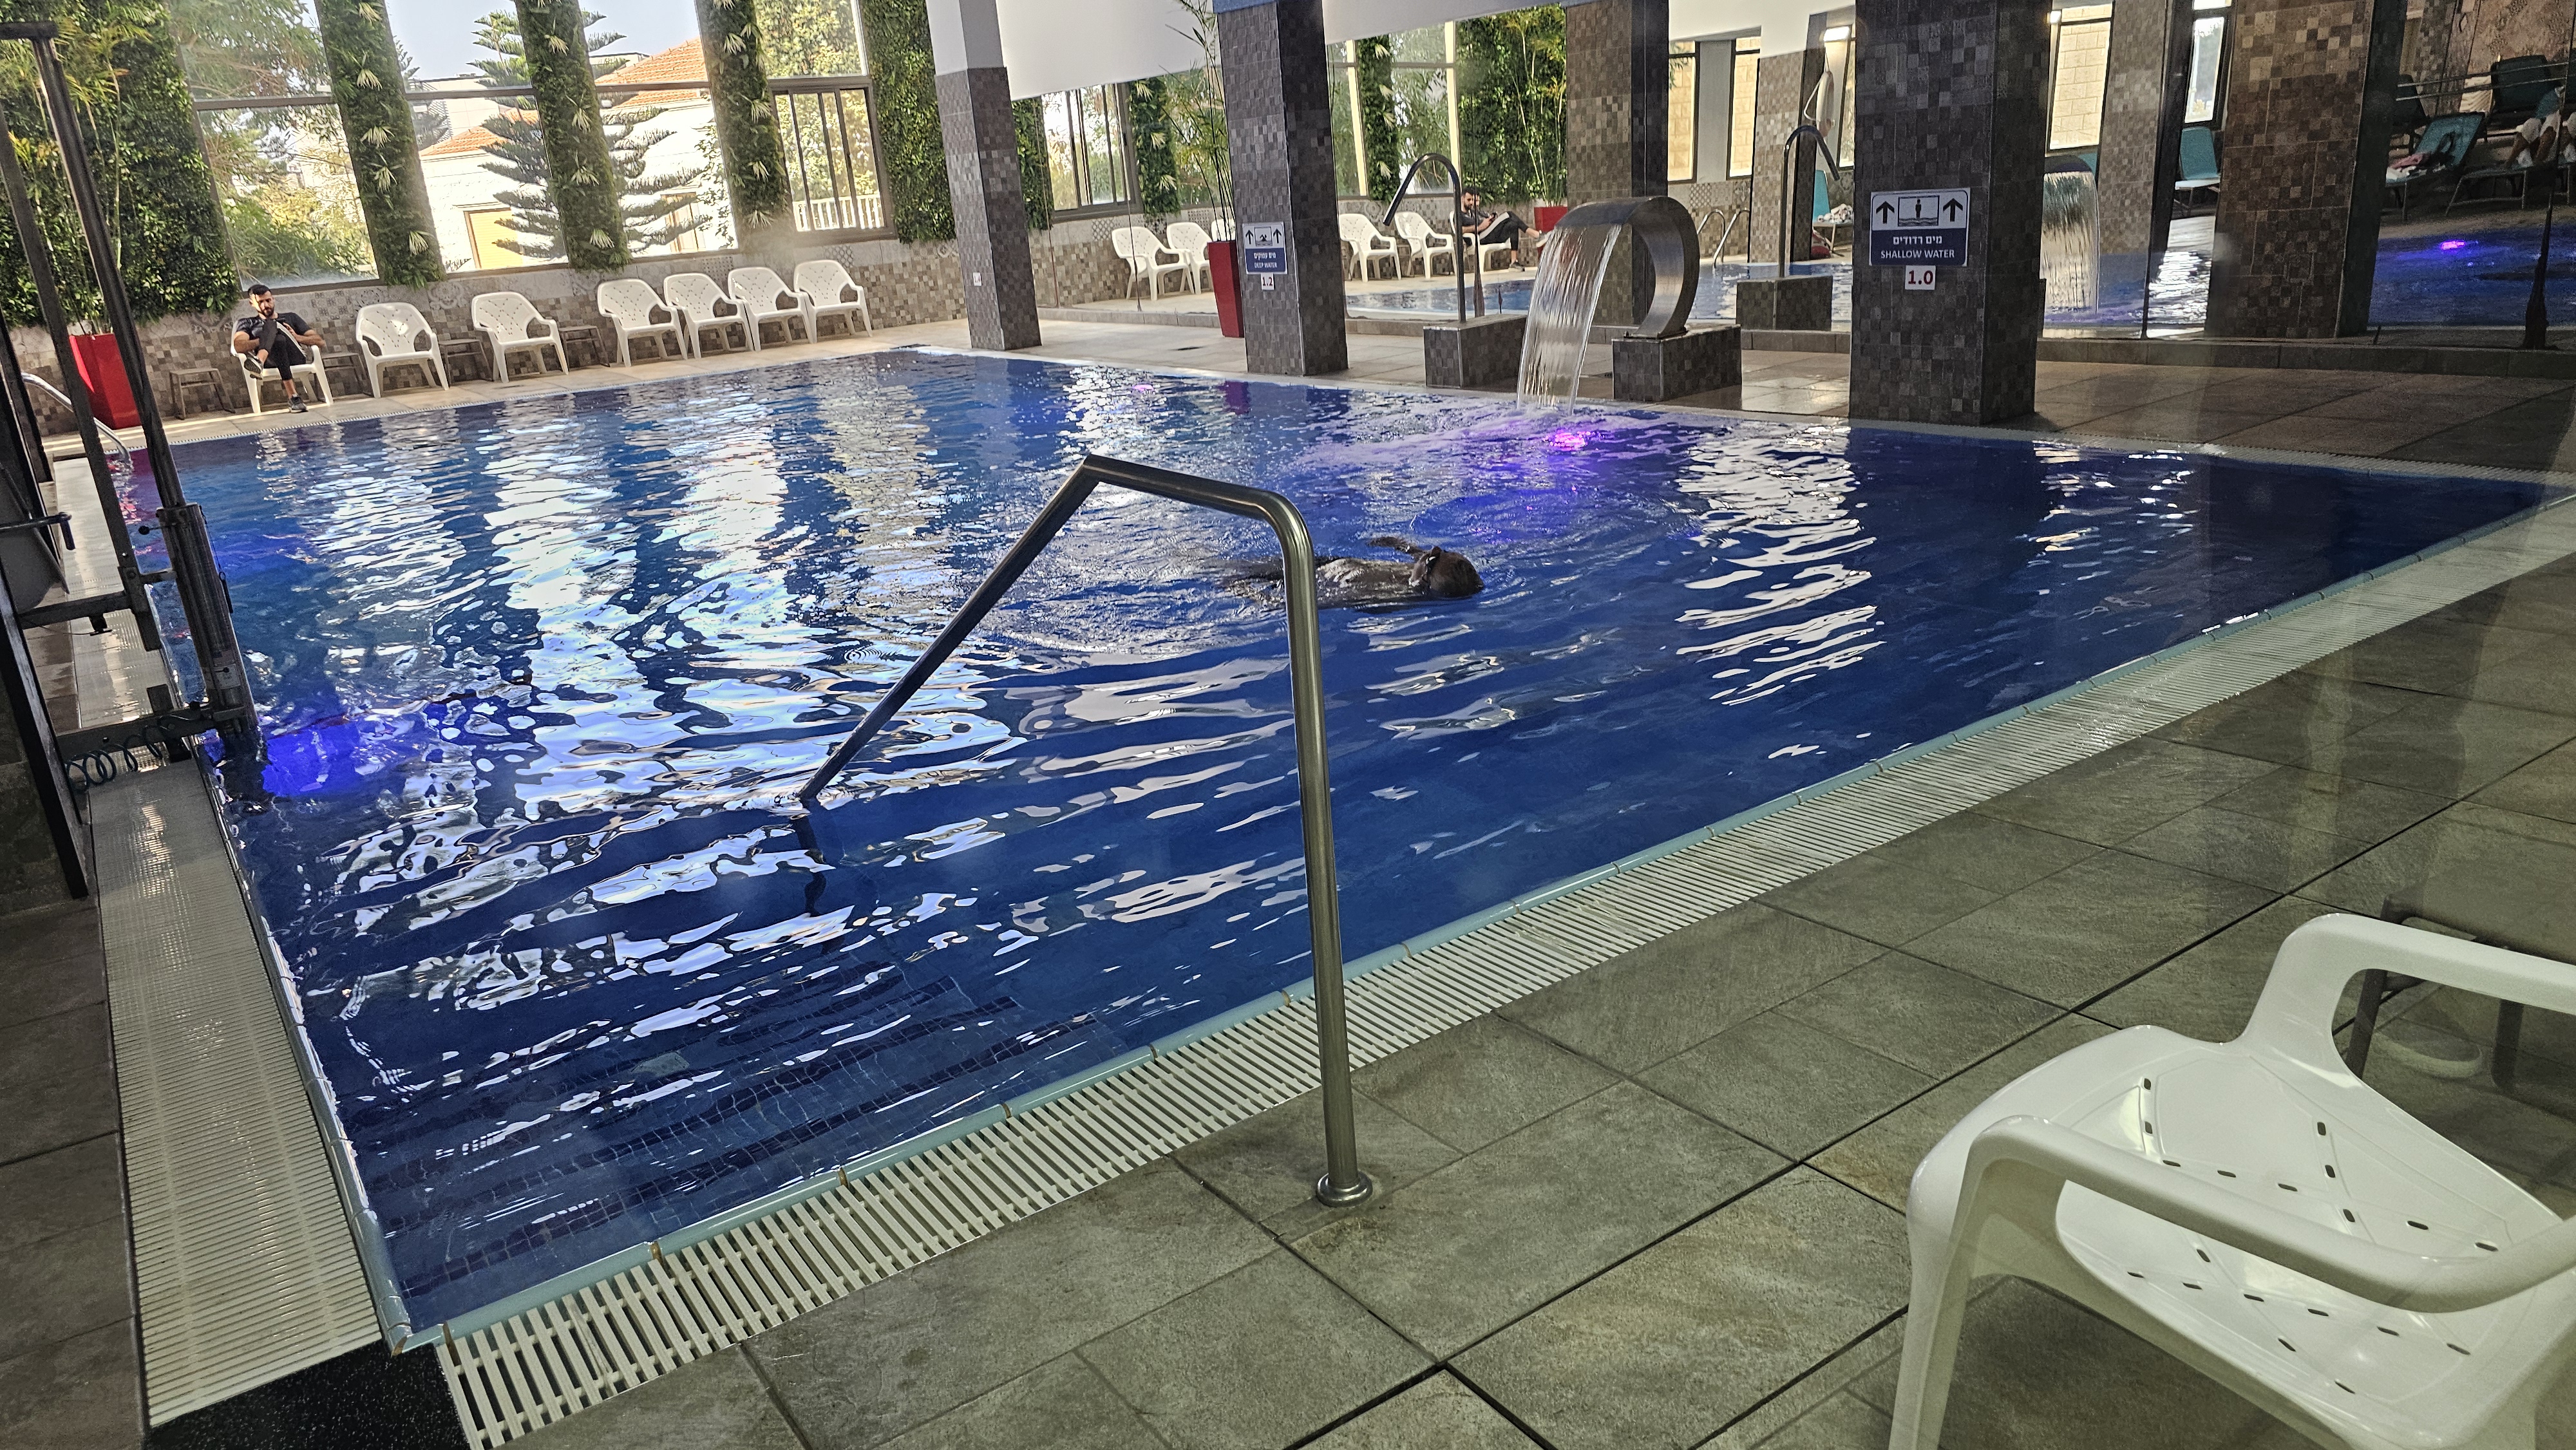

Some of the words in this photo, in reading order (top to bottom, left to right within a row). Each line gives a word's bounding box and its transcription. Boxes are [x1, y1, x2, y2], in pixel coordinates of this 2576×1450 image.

[1893, 236, 1922, 245] רדודים
[1926, 236, 1942, 244] מים
[1880, 249, 1922, 259] SHALLOW
[1924, 249, 1955, 258] WATER
[1262, 276, 1273, 286] 1.2
[1908, 270, 1933, 285] 1.0
